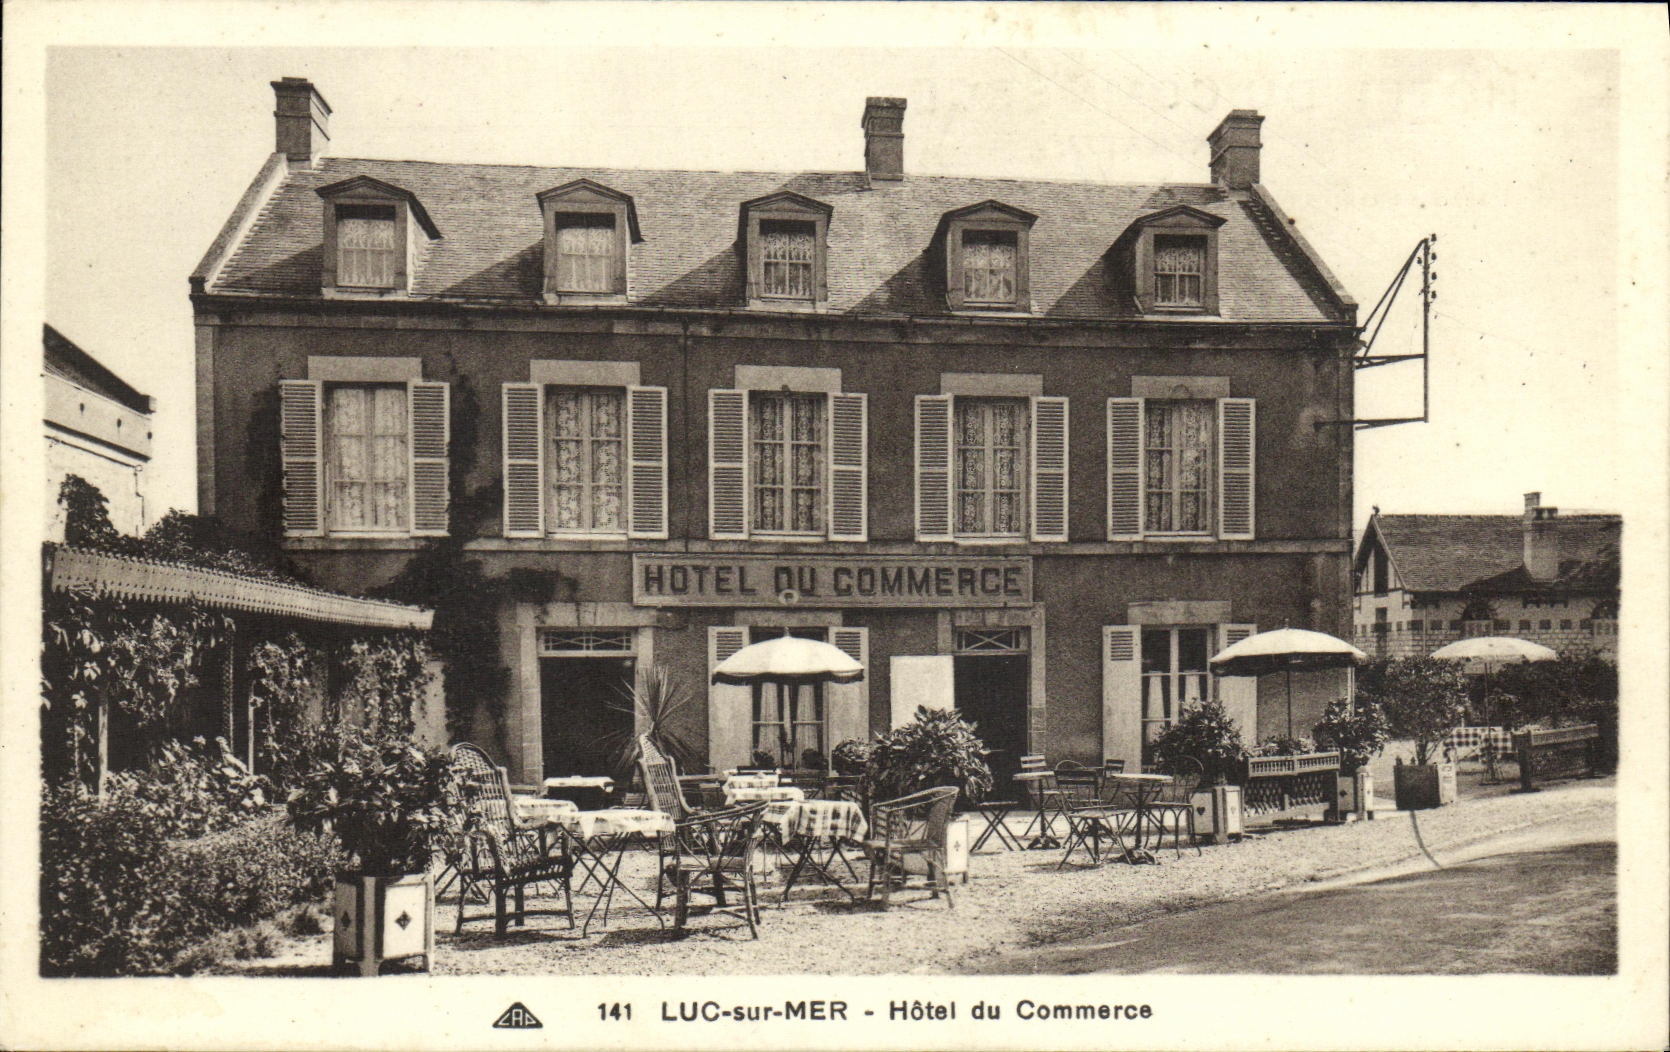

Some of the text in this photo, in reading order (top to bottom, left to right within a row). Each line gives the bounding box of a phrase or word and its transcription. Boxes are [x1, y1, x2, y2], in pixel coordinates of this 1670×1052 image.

[644, 564, 1023, 597] HOTEL DU COMMERCE
